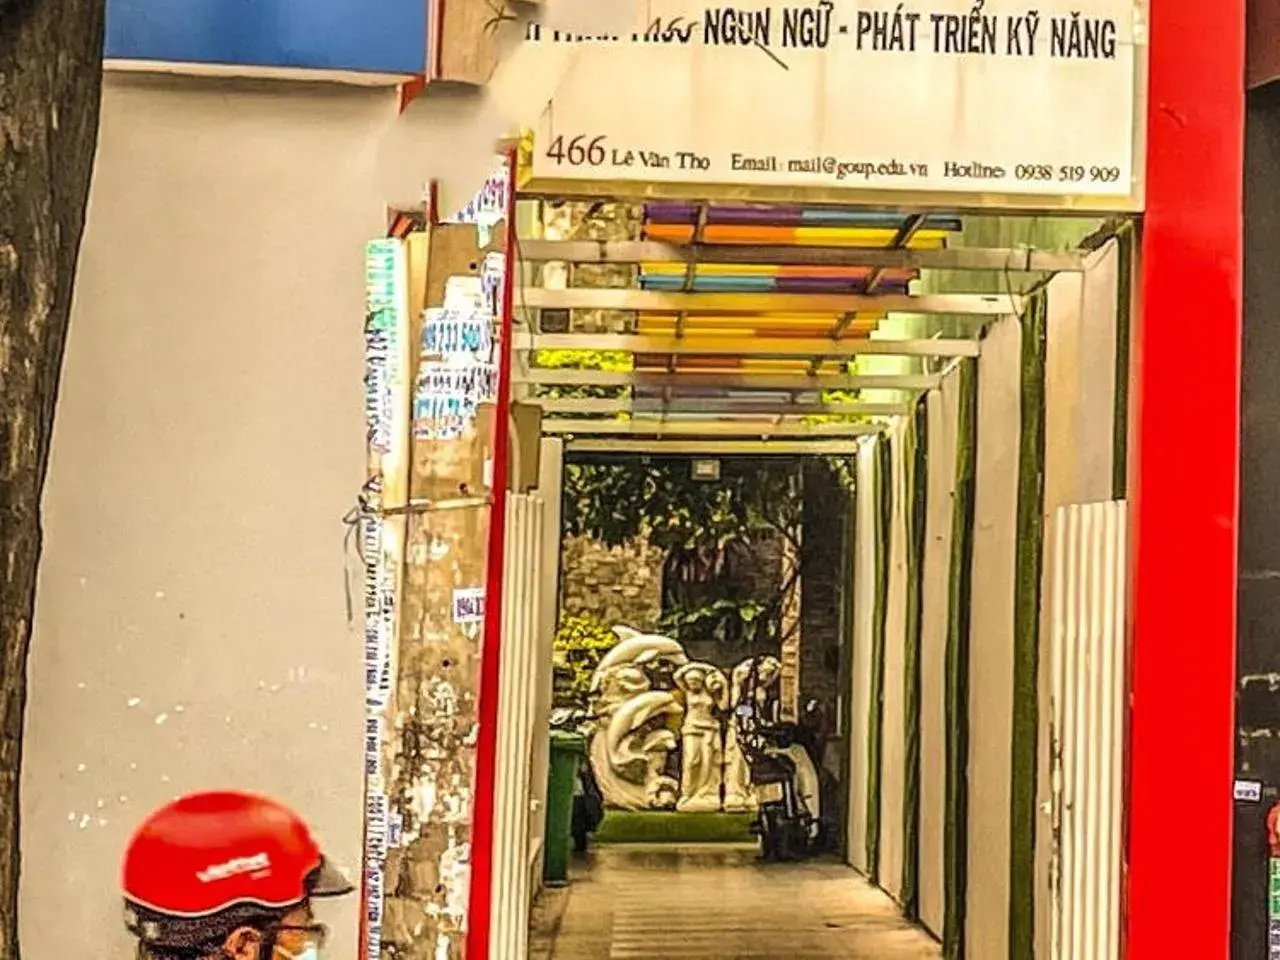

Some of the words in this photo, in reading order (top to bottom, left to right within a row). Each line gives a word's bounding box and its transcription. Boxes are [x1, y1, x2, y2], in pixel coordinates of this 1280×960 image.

[782, 0, 834, 48] NGỮ
[856, 2, 921, 51] PHÁT
[1006, 9, 1041, 56] KỸ
[1050, 11, 1116, 59] NĂNG
[545, 134, 608, 167] 466
[1090, 164, 1121, 183] 909
